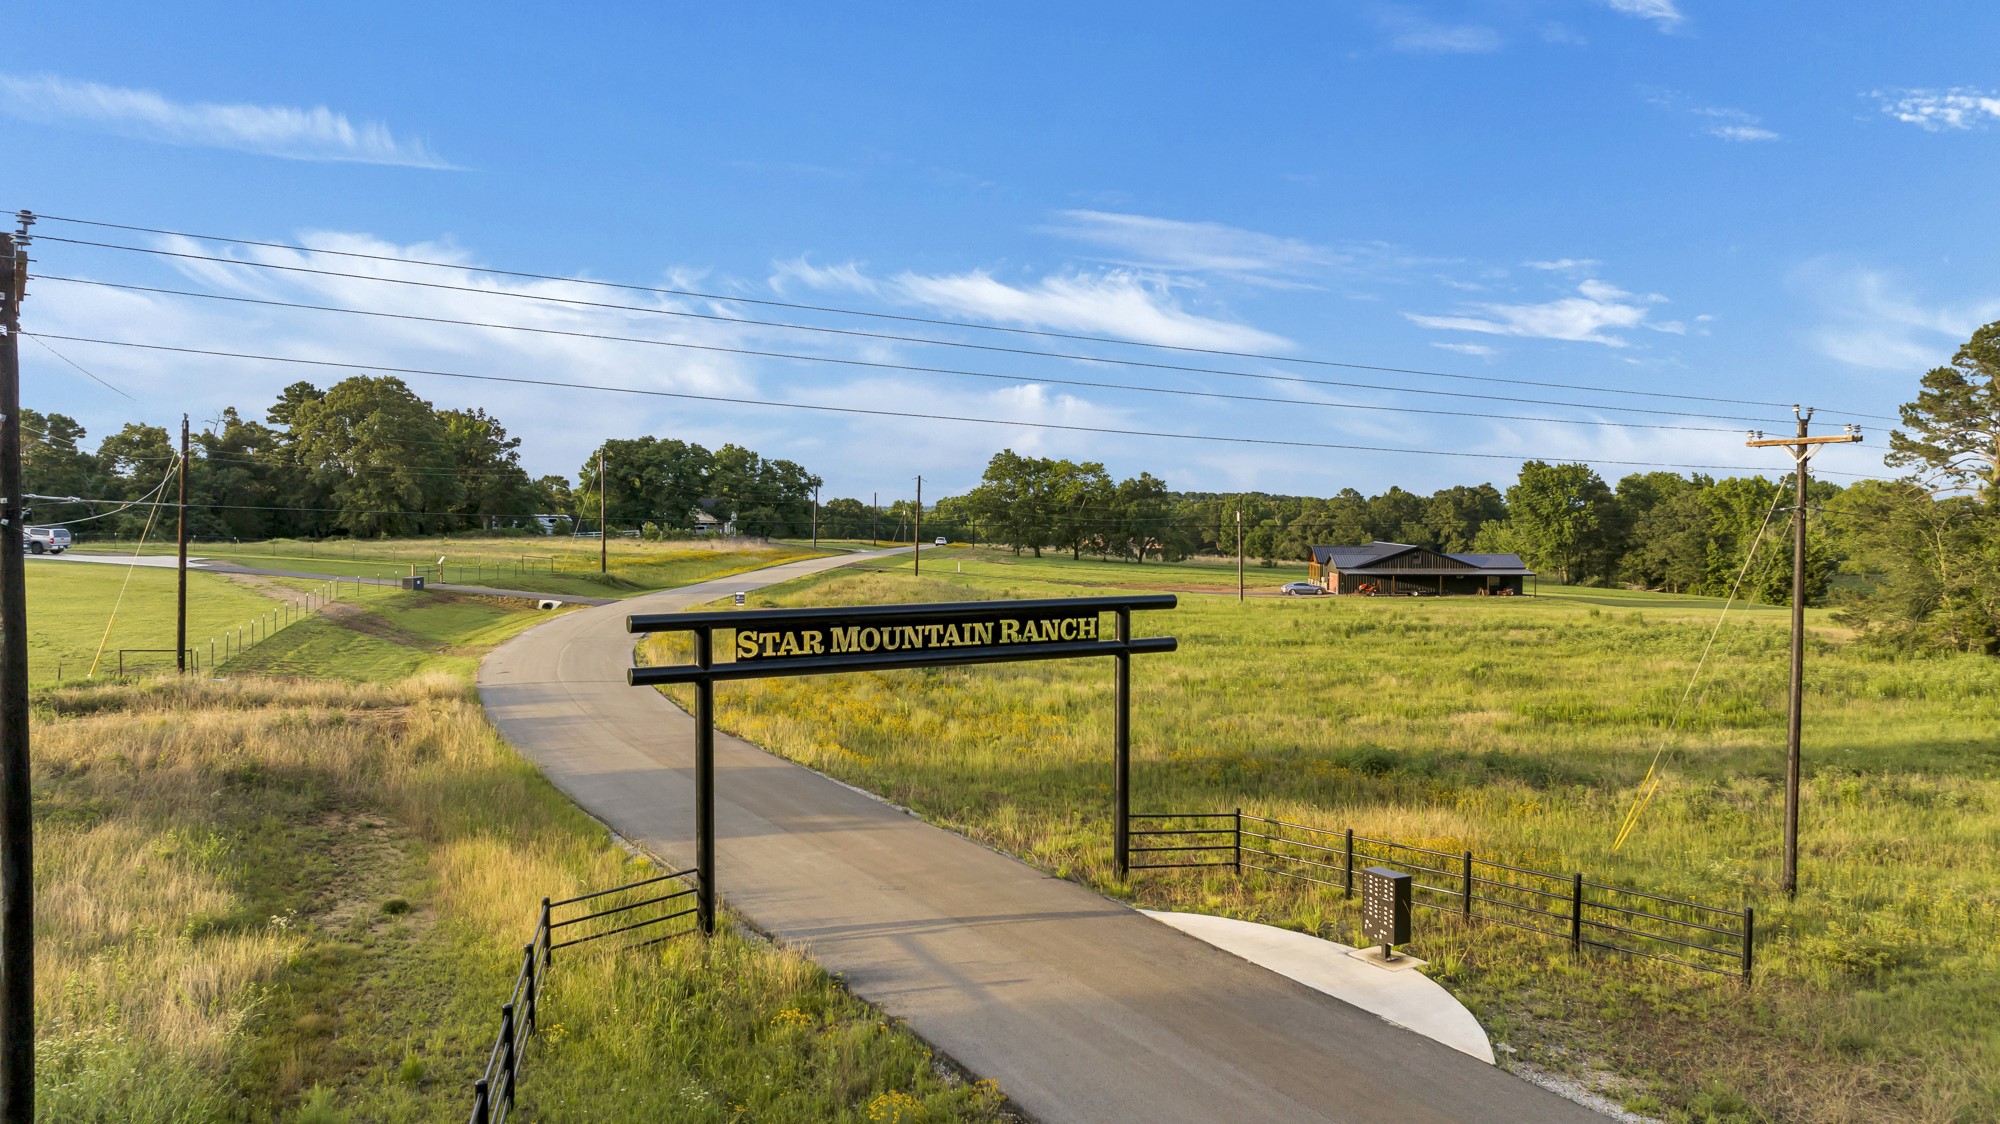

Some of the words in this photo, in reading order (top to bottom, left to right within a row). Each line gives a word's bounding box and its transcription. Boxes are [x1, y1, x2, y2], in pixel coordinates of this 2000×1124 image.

[737, 630, 825, 659] STAR
[830, 622, 994, 653] MOUNTAIN
[999, 617, 1098, 644] RANCH
